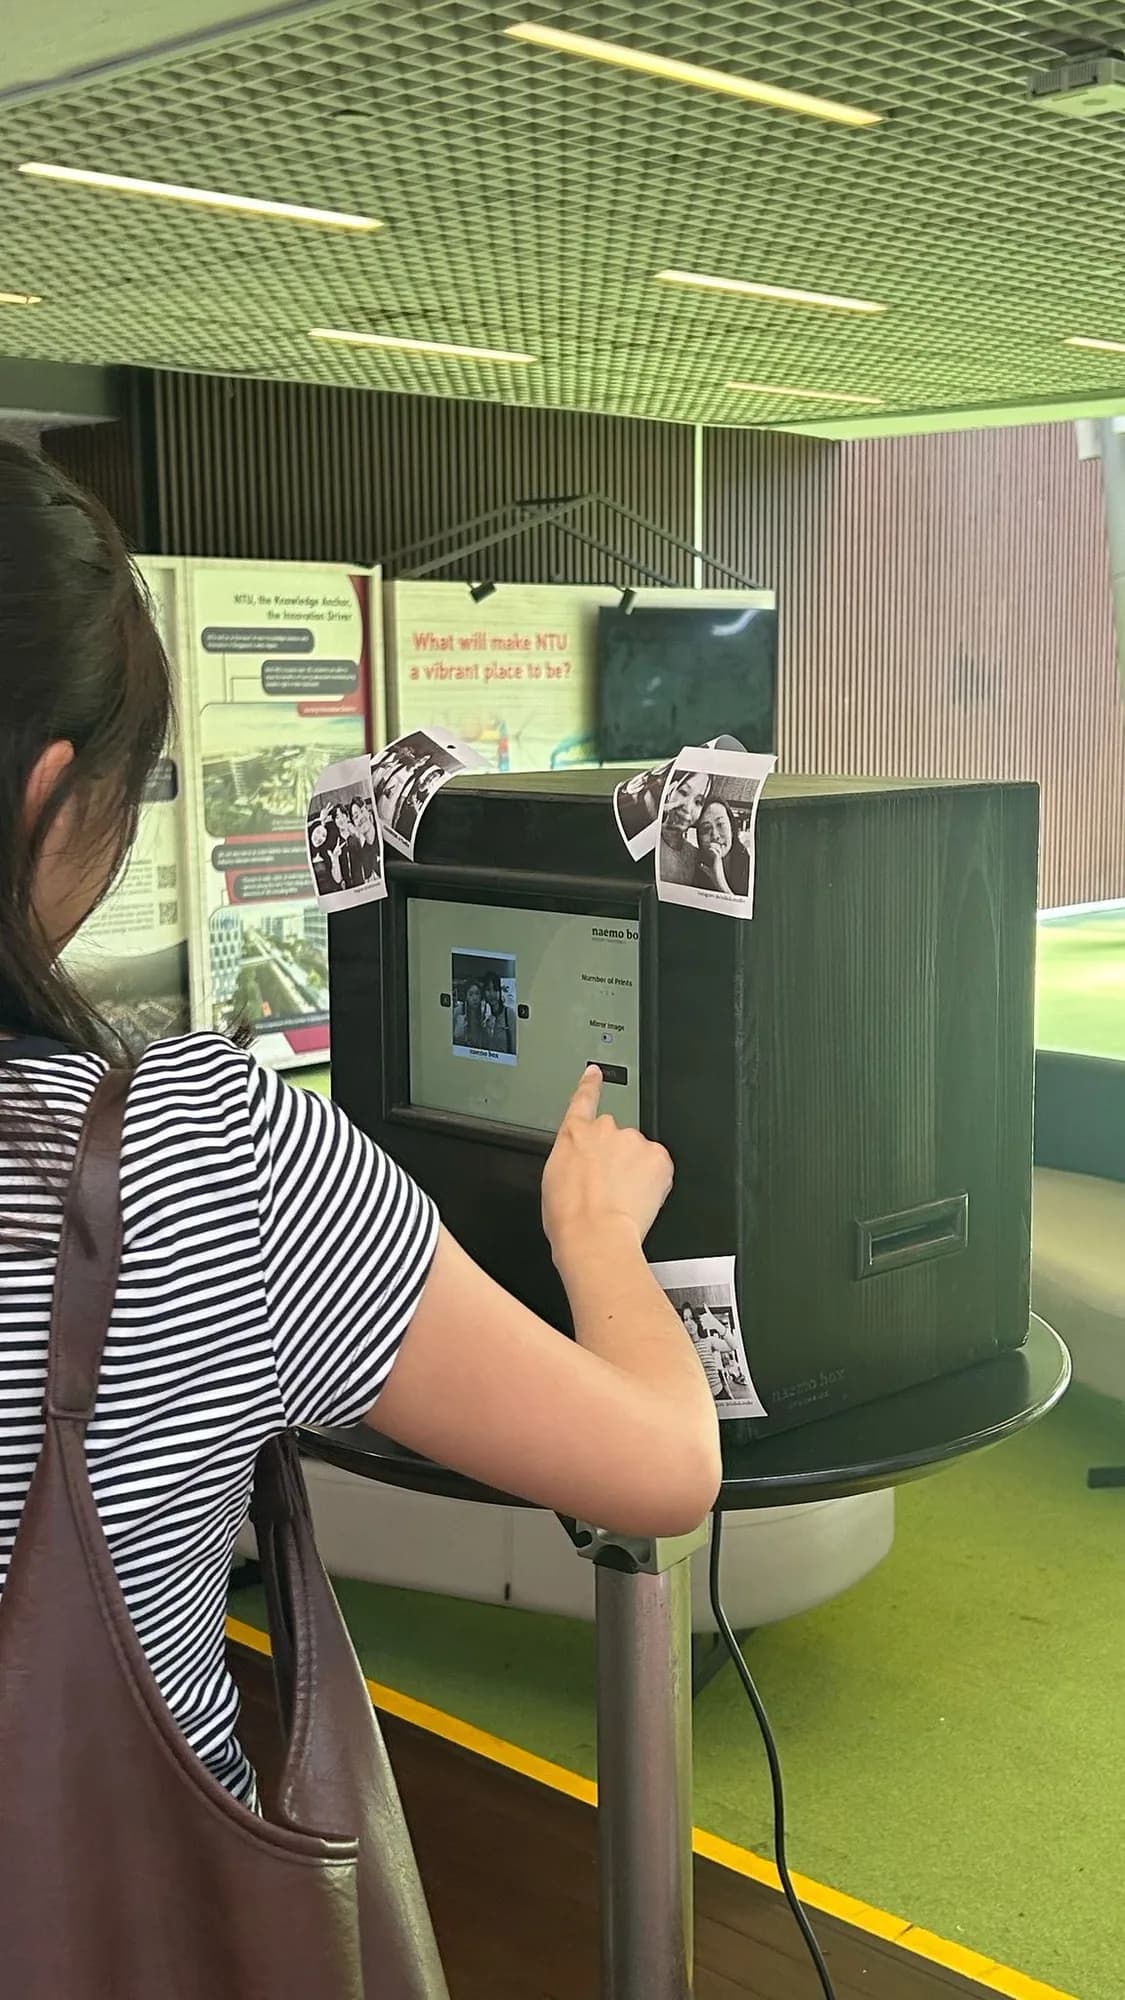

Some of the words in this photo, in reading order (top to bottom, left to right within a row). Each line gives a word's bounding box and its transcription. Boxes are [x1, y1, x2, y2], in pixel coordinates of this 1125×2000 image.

[233, 594, 256, 606] NTU,
[258, 595, 271, 605] the
[274, 595, 319, 608] Knowledge
[322, 597, 352, 607] Anchor,
[267, 610, 280, 620] the
[283, 610, 324, 621] Innovation
[327, 612, 353, 621] Driver
[413, 632, 454, 651] What
[459, 632, 487, 651] will
[491, 633, 531, 651] make
[536, 633, 568, 651] NTU
[409, 666, 419, 680] a
[424, 661, 479, 680] vibrant
[484, 662, 522, 684] place
[527, 663, 541, 680] to
[545, 661, 571, 680] be?
[592, 928, 624, 938] naemo
[626, 928, 639, 940] bo
[581, 974, 606, 984] Number
[607, 976, 614, 984] of
[614, 978, 633, 987] Prints
[589, 1019, 607, 1028] Mirror
